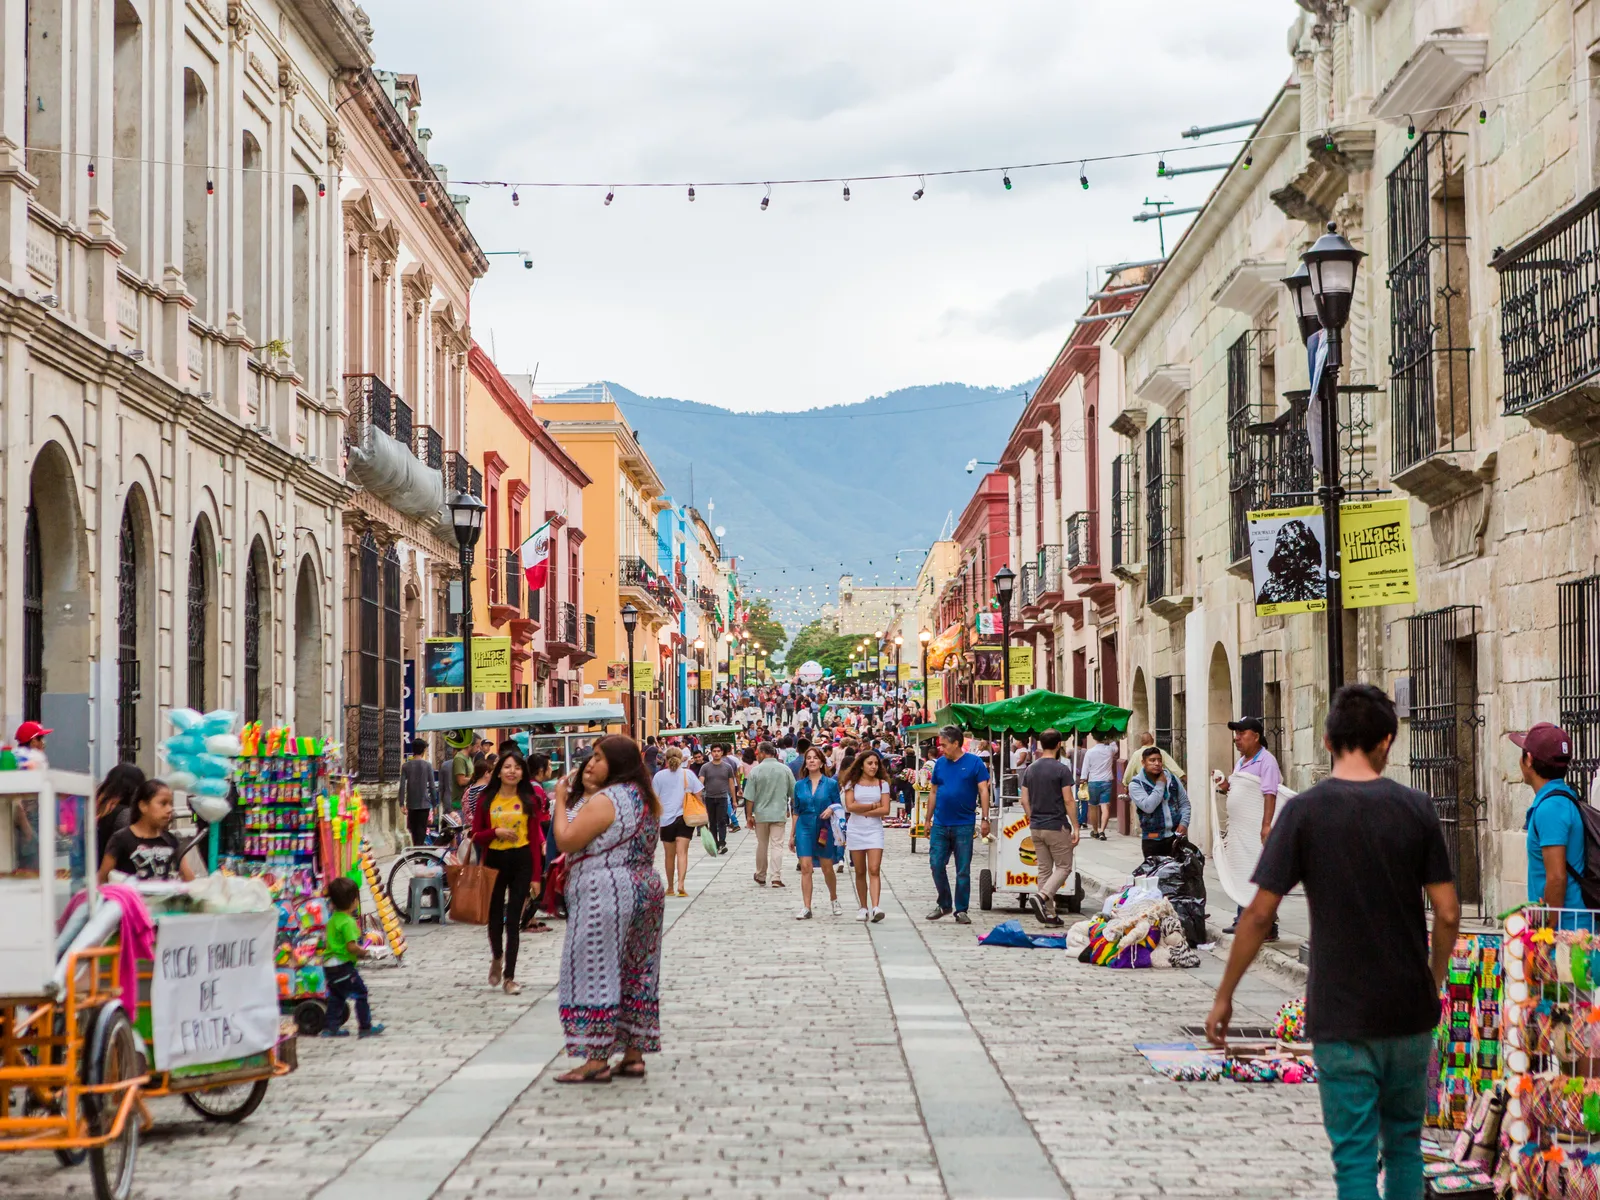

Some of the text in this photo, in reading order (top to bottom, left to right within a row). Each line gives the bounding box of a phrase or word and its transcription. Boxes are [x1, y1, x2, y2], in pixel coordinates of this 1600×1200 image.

[1346, 537, 1406, 561] filmfest
[162, 938, 258, 980] RICO PONCHE
[200, 977, 222, 1012] DE
[180, 1013, 243, 1054] FRUTAS
